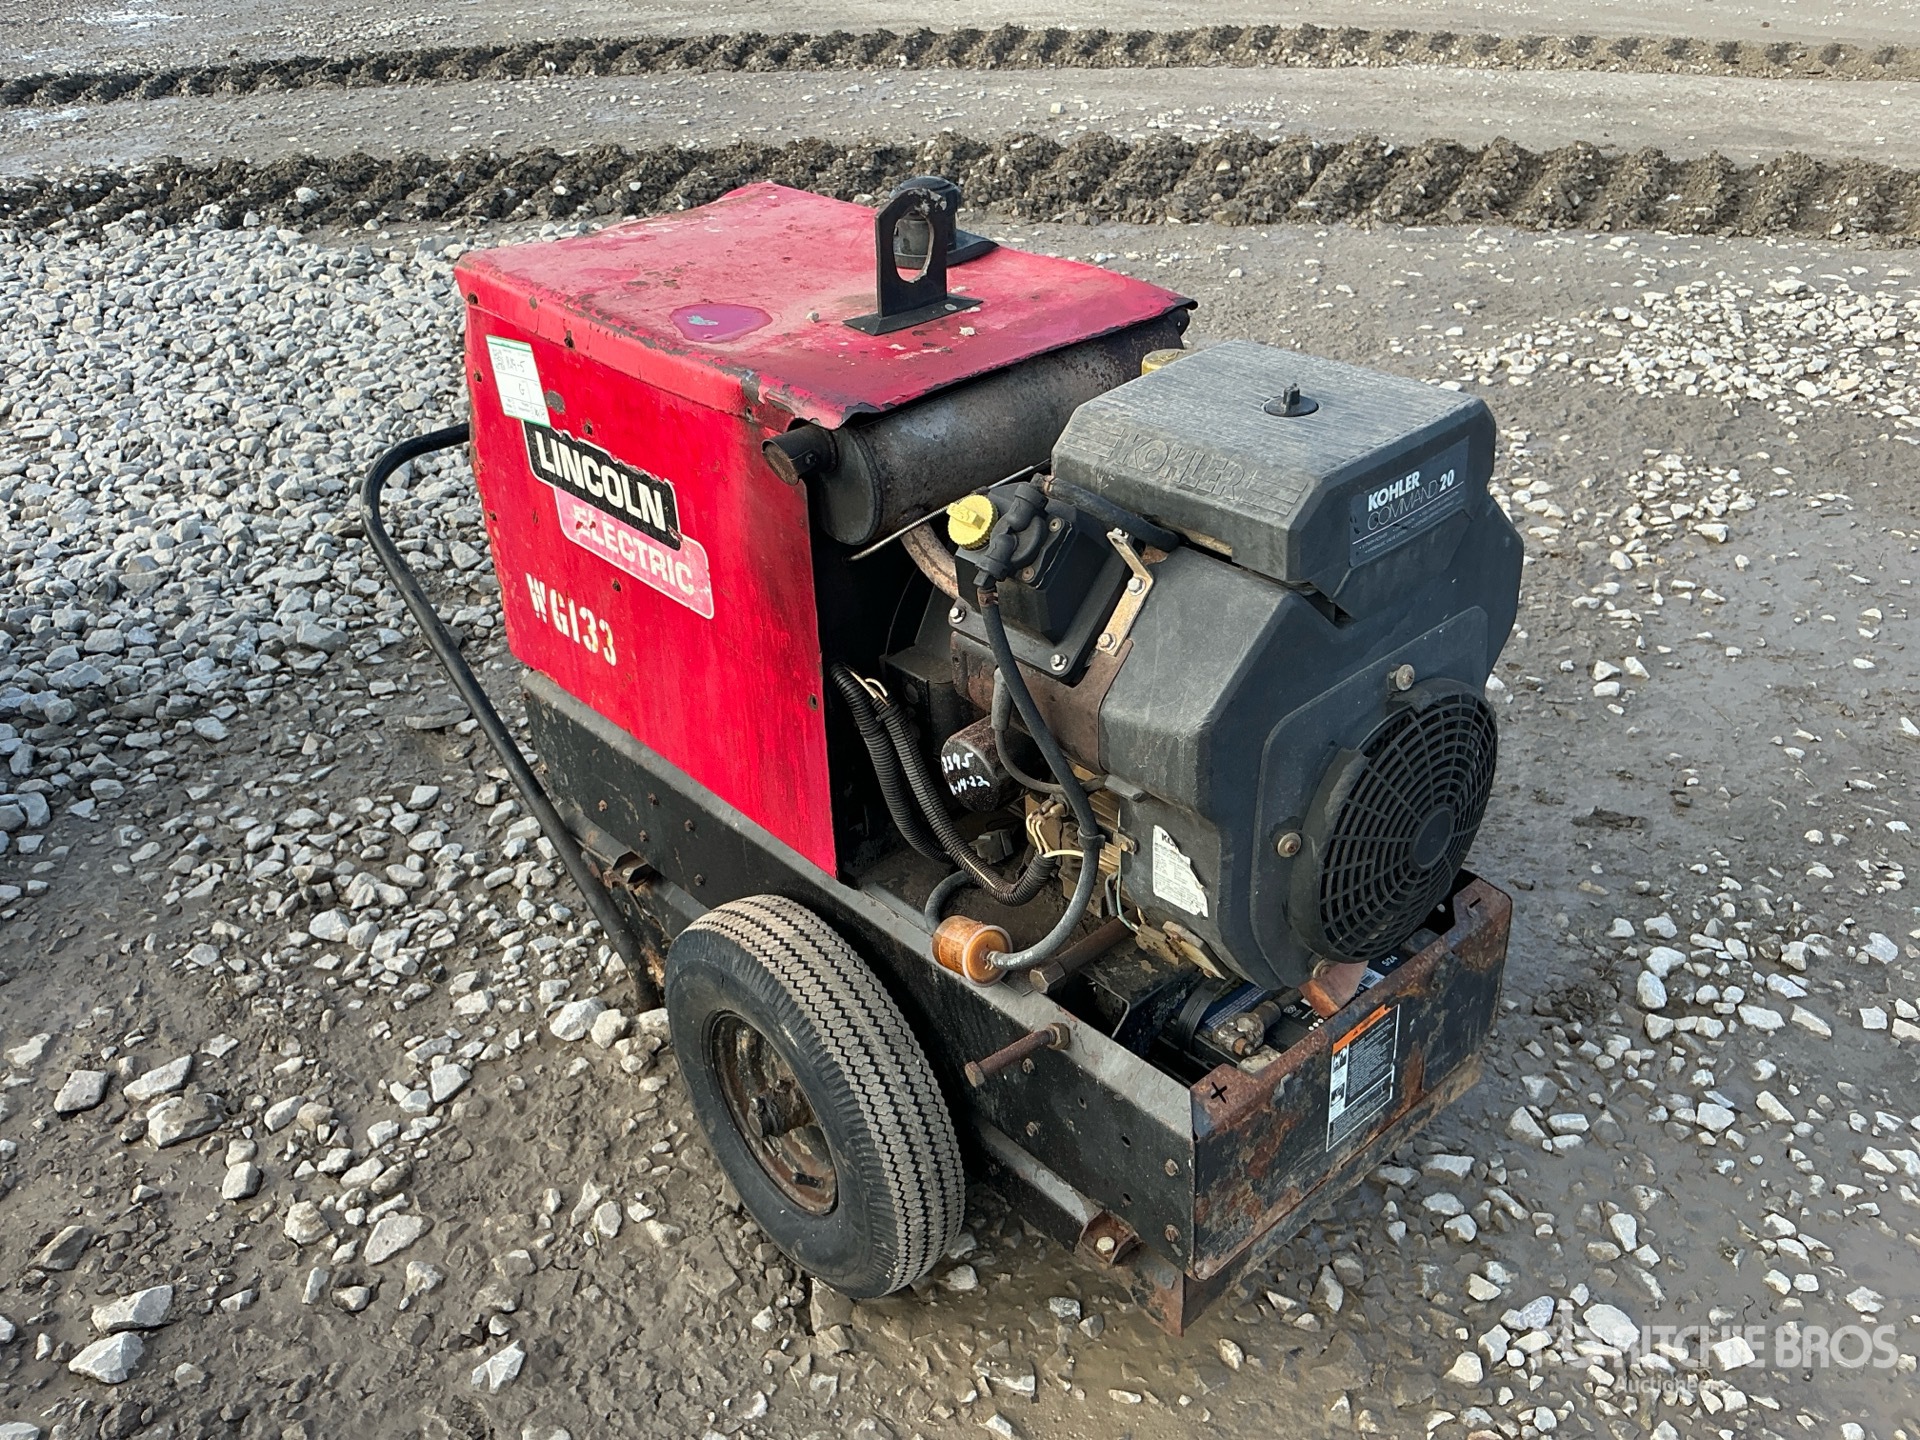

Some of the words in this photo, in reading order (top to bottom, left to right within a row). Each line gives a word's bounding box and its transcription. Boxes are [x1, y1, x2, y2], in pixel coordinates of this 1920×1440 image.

[534, 430, 667, 532] LINCOLN
[1113, 432, 1246, 501] KOHLER
[1367, 479, 1438, 531] COMMAND
[1439, 468, 1455, 492] 20
[1368, 470, 1420, 512] KOHLER
[572, 503, 695, 597] ELECTRIC
[525, 572, 617, 667] WG133
